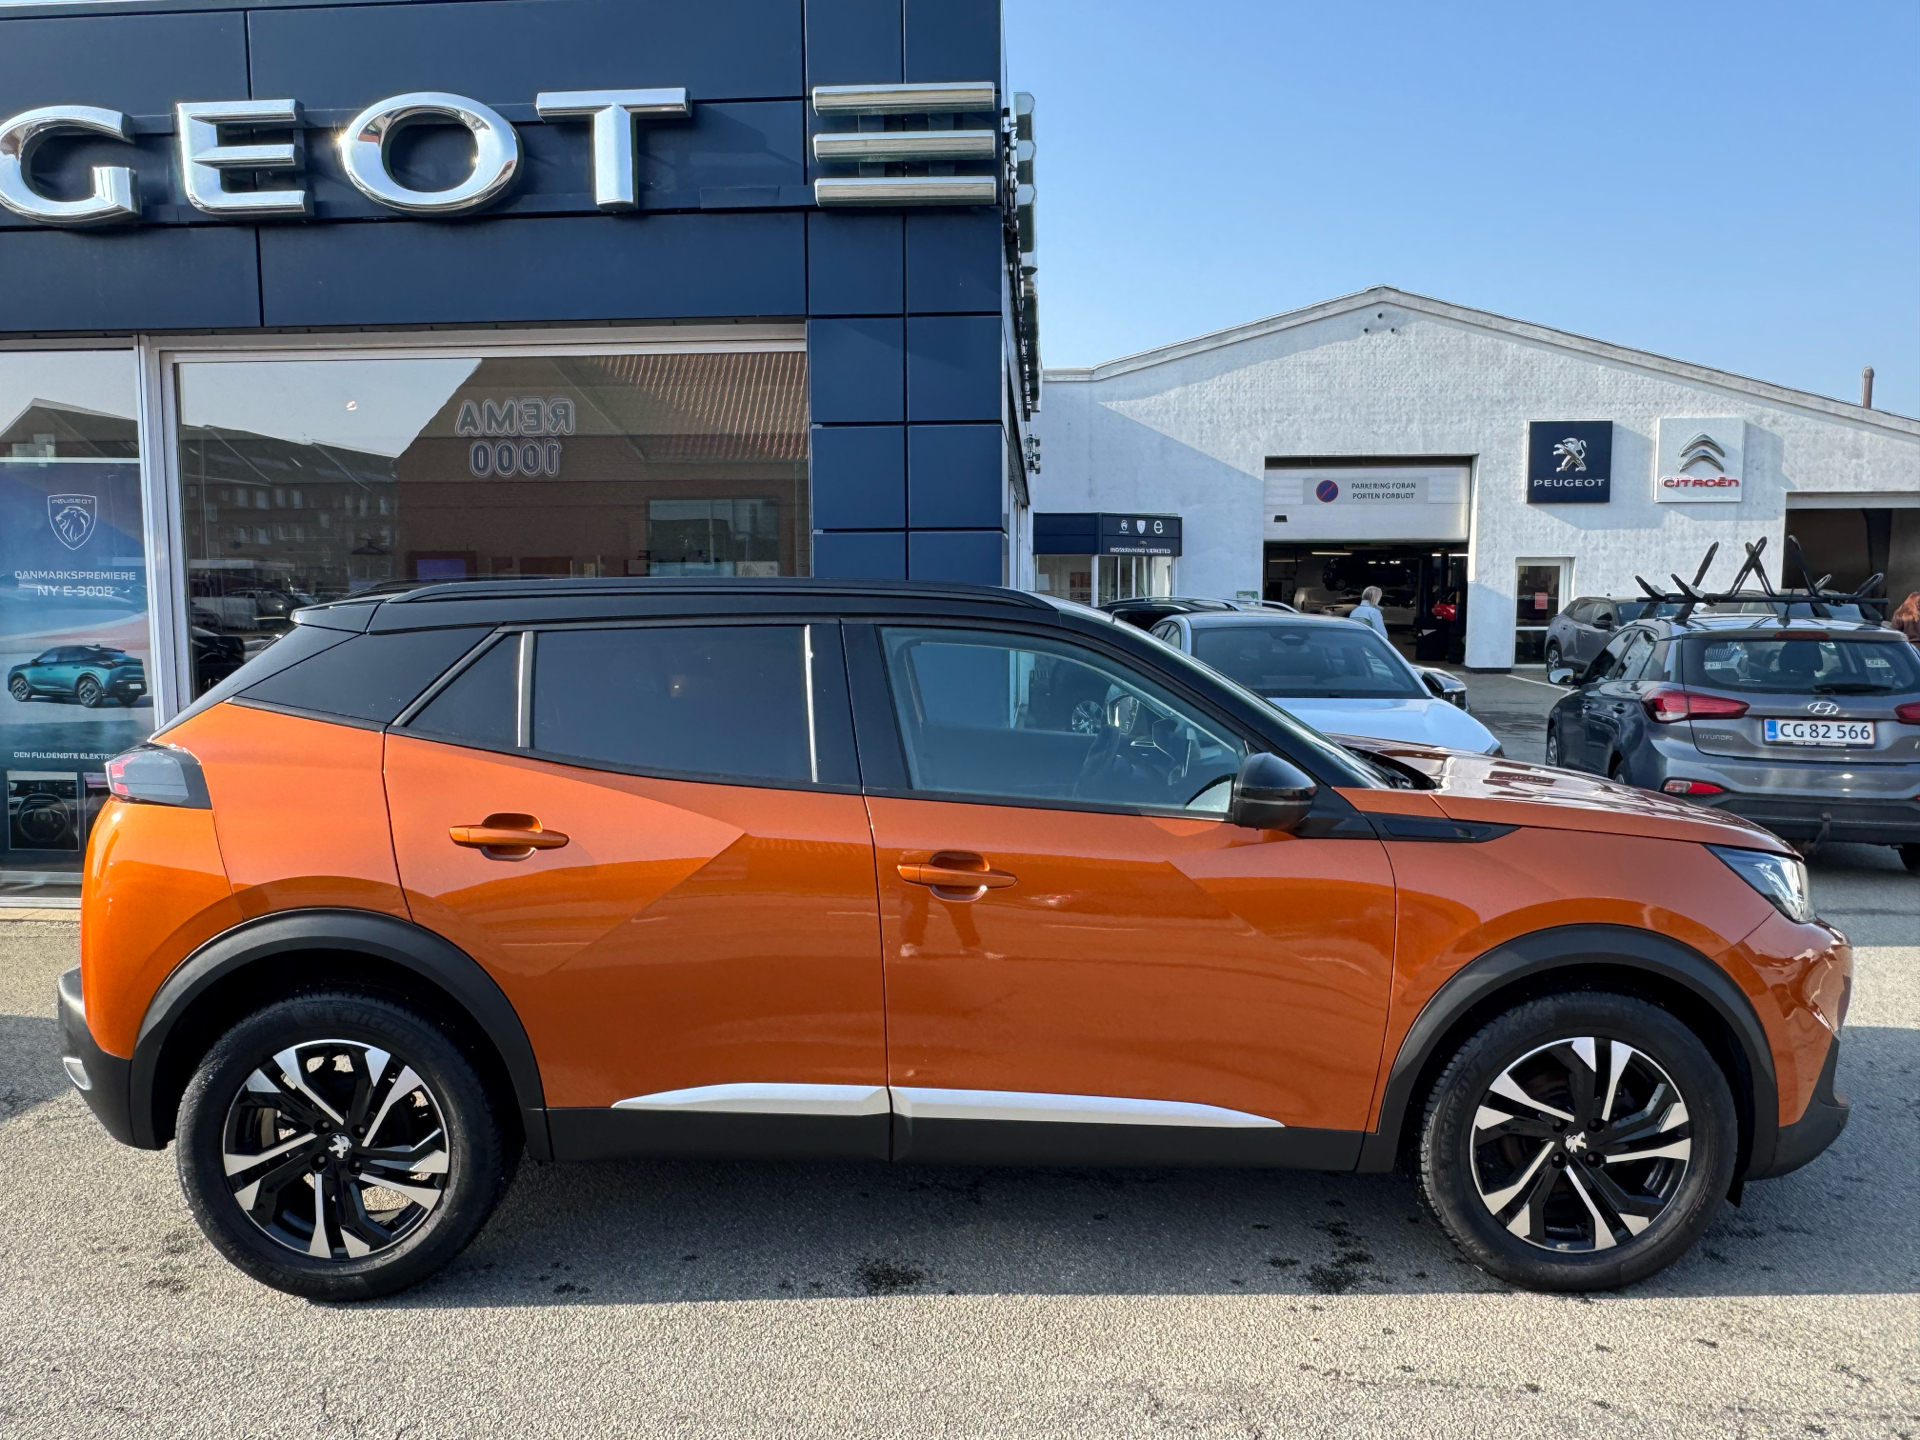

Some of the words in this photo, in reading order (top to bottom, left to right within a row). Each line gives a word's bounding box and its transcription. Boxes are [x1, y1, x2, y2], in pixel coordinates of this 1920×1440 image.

[1533, 478, 1605, 487] PEUGEOT
[14, 570, 137, 581] DANMARKSPREMIERE
[37, 585, 60, 597] NY
[1779, 722, 1805, 739] CG
[1809, 724, 1832, 740] 82
[1836, 725, 1872, 741] 566
[13, 751, 31, 759] DEN
